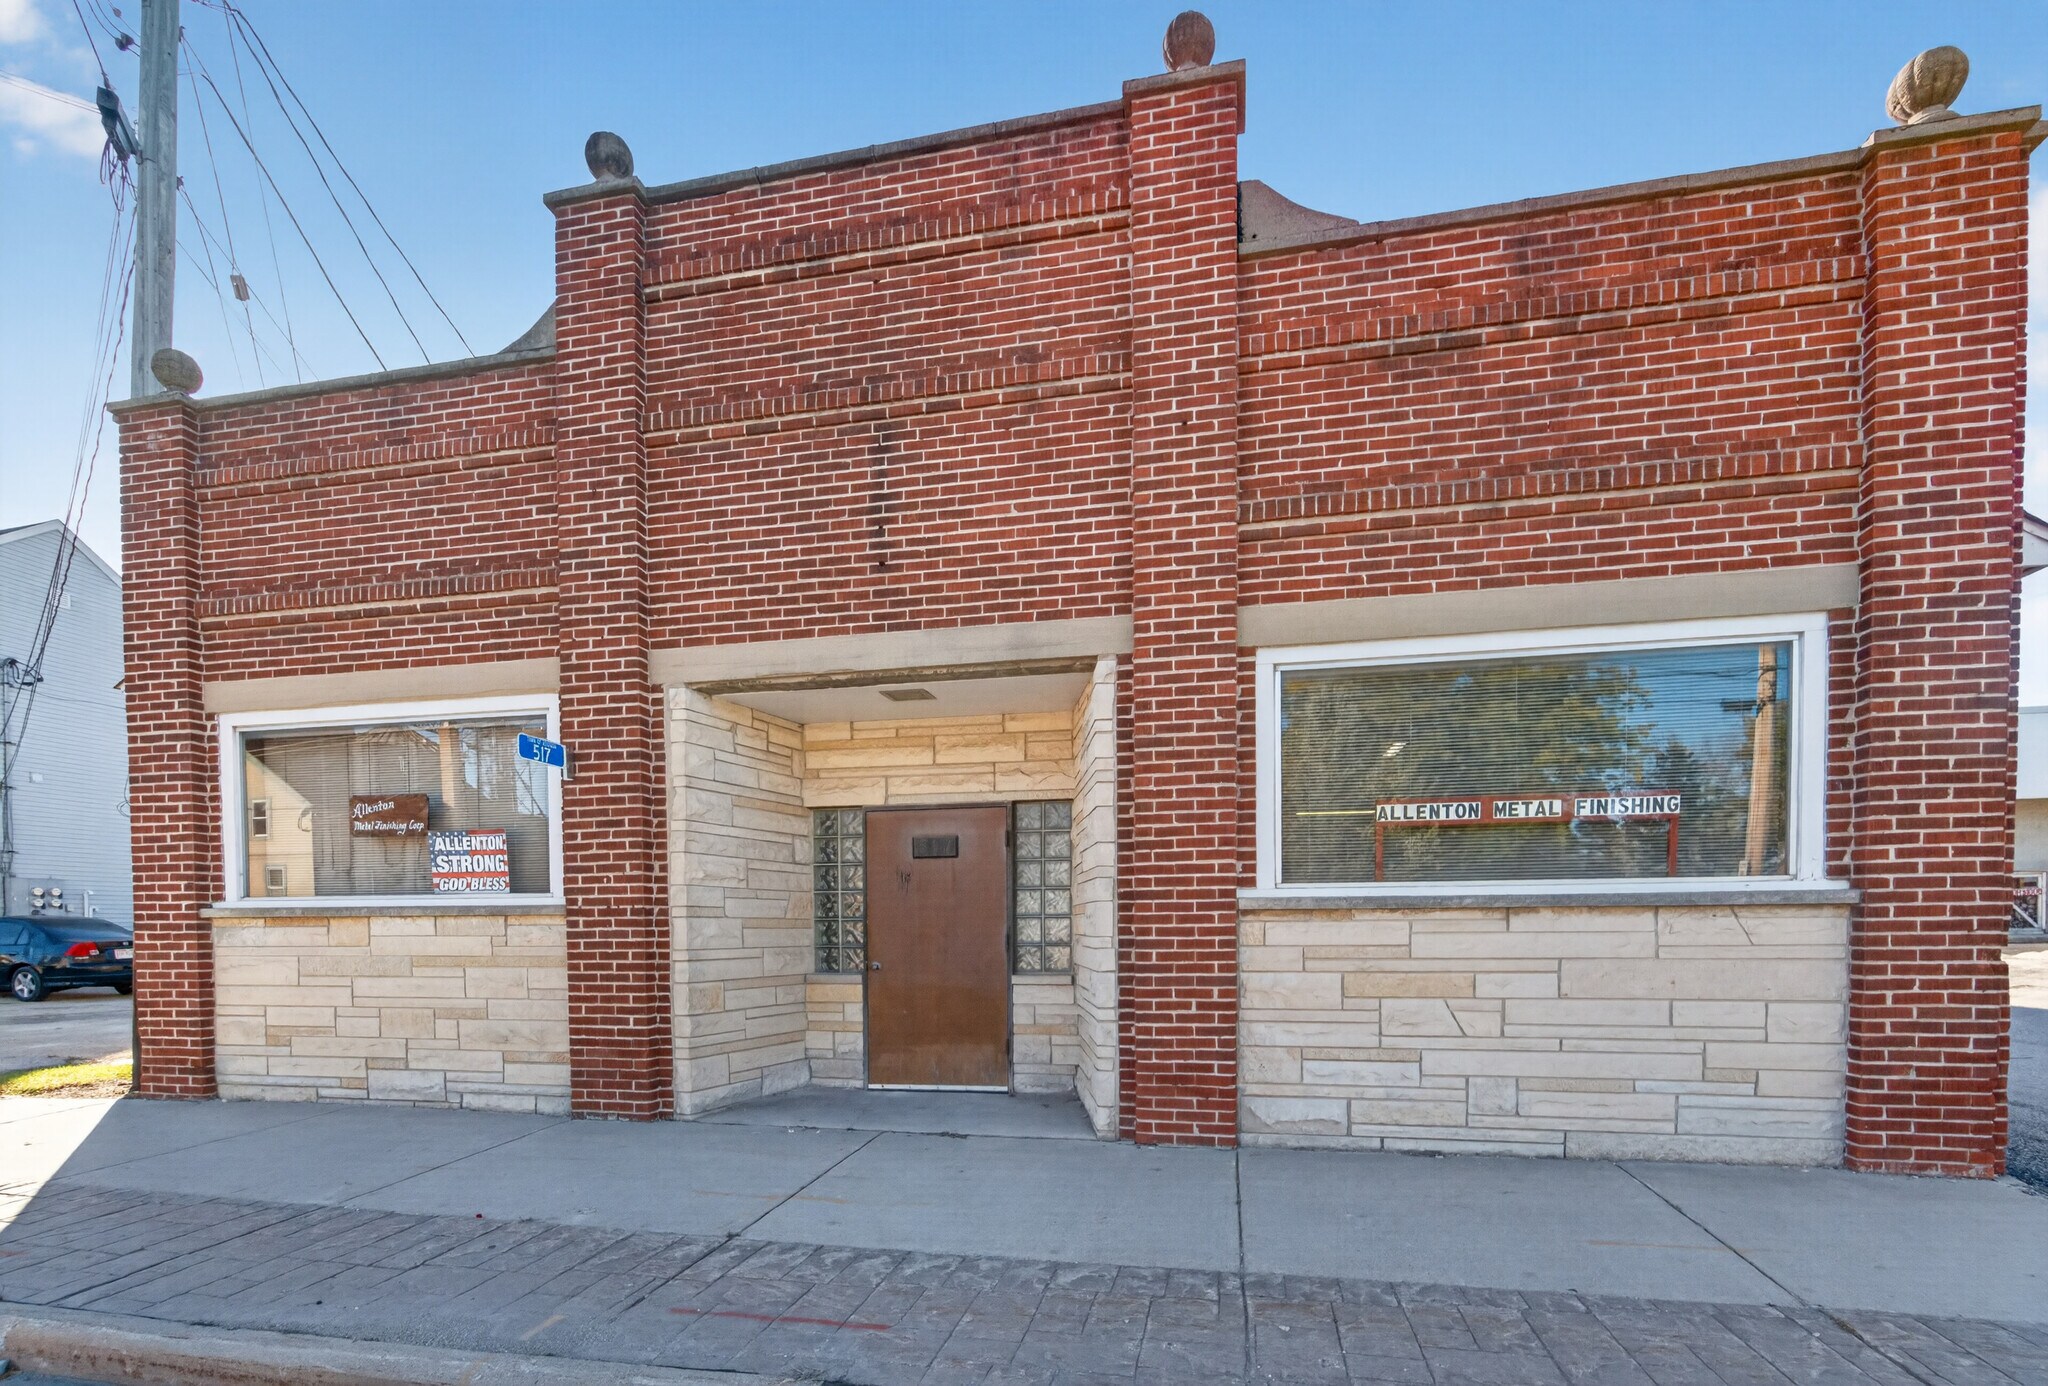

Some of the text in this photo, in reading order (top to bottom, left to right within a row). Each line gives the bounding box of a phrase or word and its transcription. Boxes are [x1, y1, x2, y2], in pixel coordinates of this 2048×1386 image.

[533, 744, 551, 763] 517
[352, 801, 394, 818] Allenton
[1378, 797, 1679, 821] ALLENTON METAL FINISHING
[354, 821, 374, 832] Metal
[375, 820, 406, 835] Finishing
[434, 836, 503, 850] ALLENTON
[436, 855, 504, 872] STRONG
[440, 878, 506, 891] GOD BLESS
